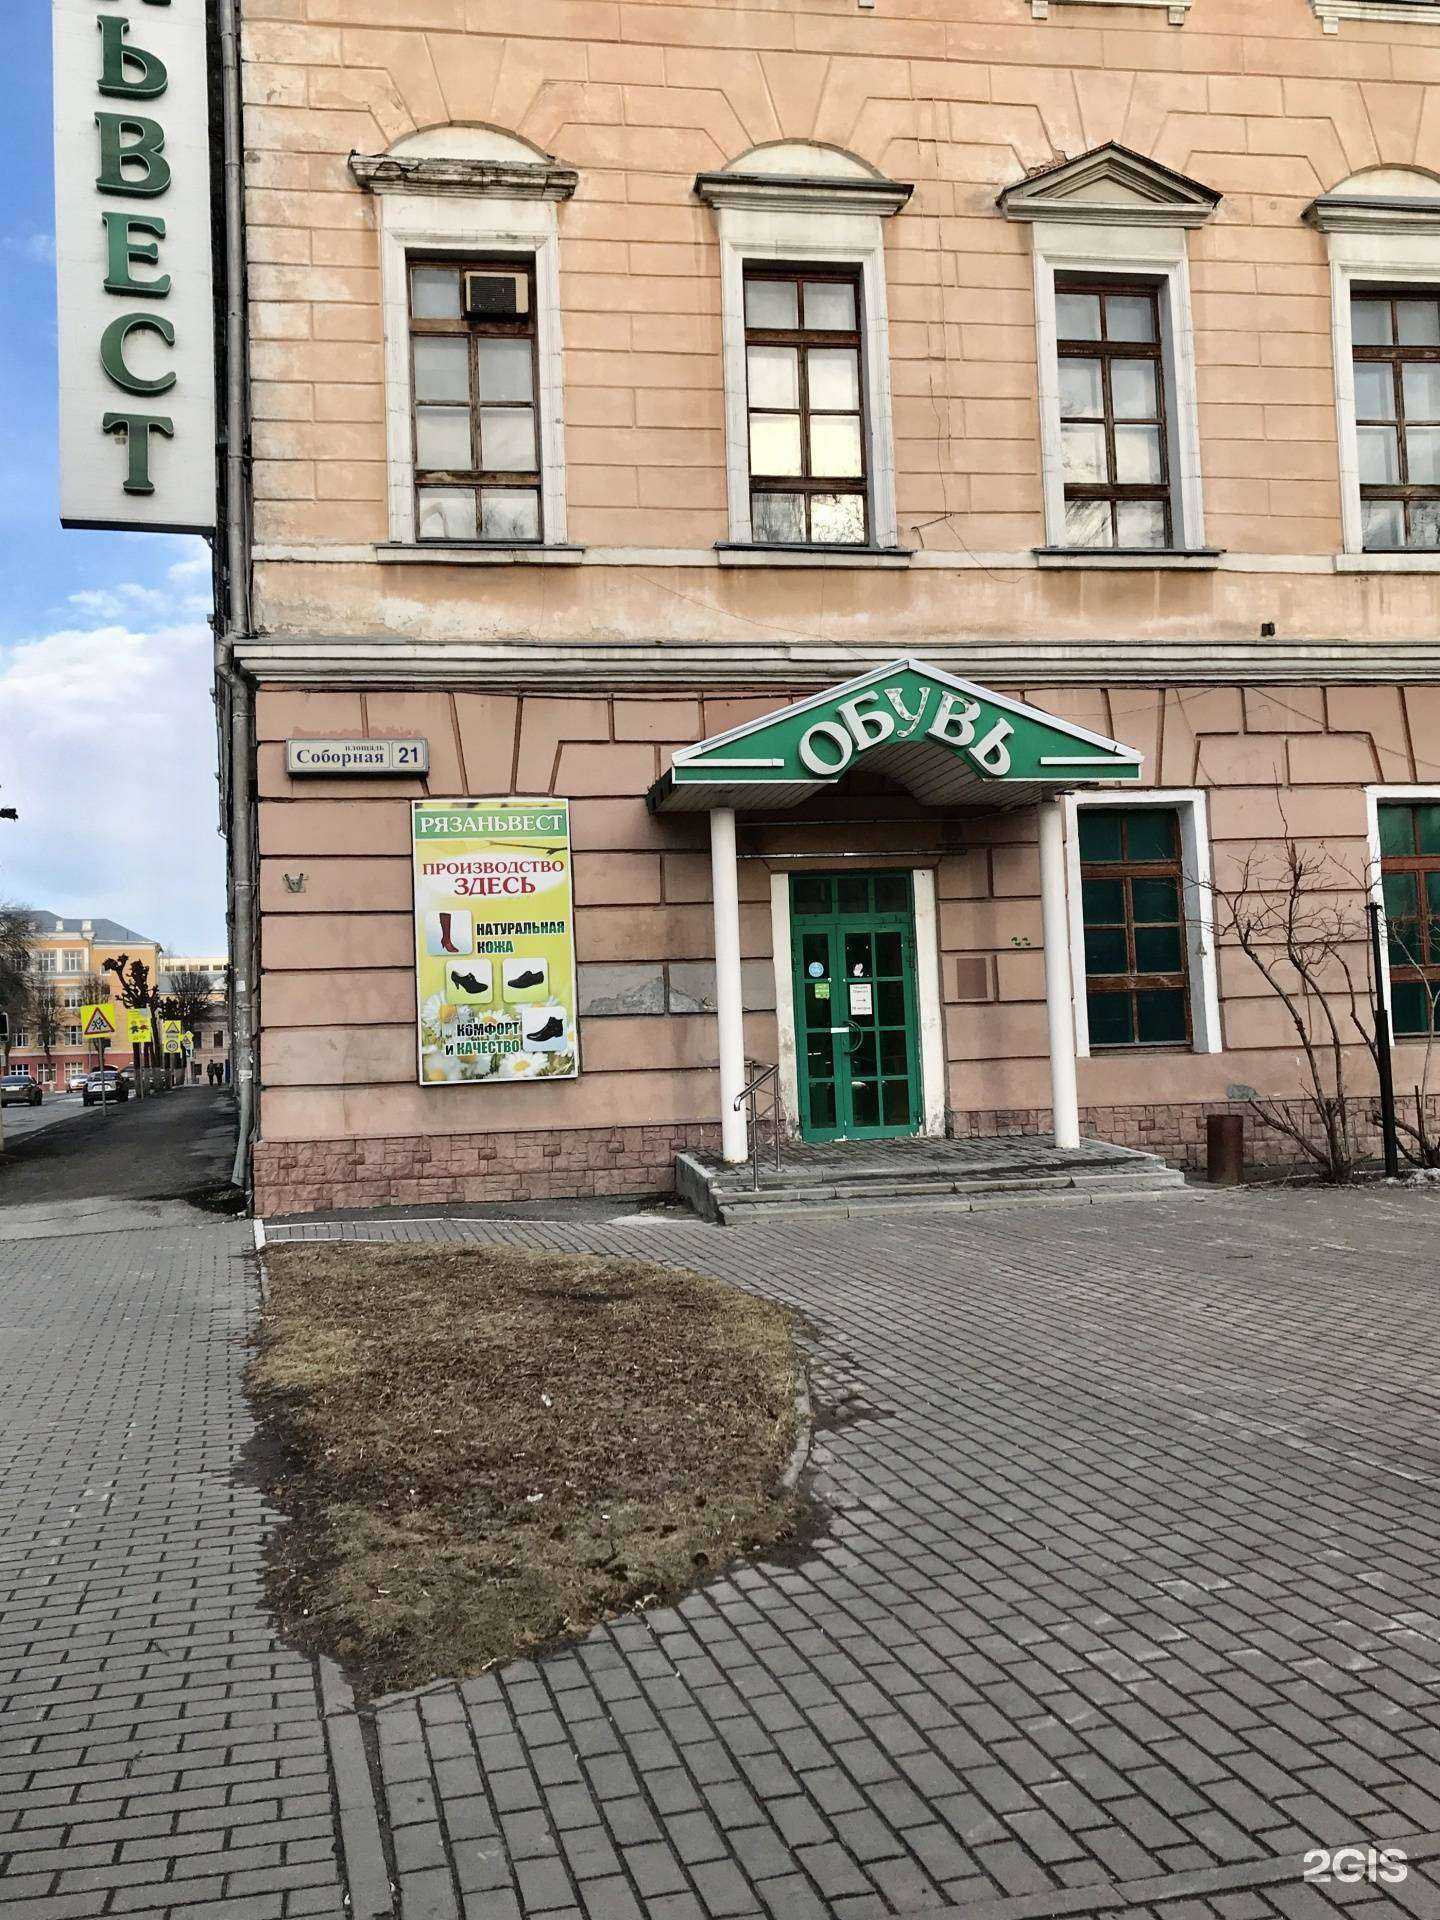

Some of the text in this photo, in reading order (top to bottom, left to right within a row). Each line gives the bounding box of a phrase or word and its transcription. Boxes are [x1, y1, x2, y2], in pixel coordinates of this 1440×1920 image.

[94, 0, 177, 496] ЬВЕСТ
[799, 687, 1014, 776] ОБУВЬ
[296, 747, 418, 767] Соборная 21
[419, 814, 563, 833] РЯЗАНЬВЕСТ
[422, 860, 564, 875] ПРОИЗВОДСТВО
[453, 877, 536, 896] ЗДЕСЬ
[476, 920, 565, 936] НАТУРАЛЬНАЯ
[477, 941, 514, 954] КОЖА
[456, 1022, 519, 1036] КОМФОРТ
[456, 1040, 520, 1054] КАЧЕСТВО
